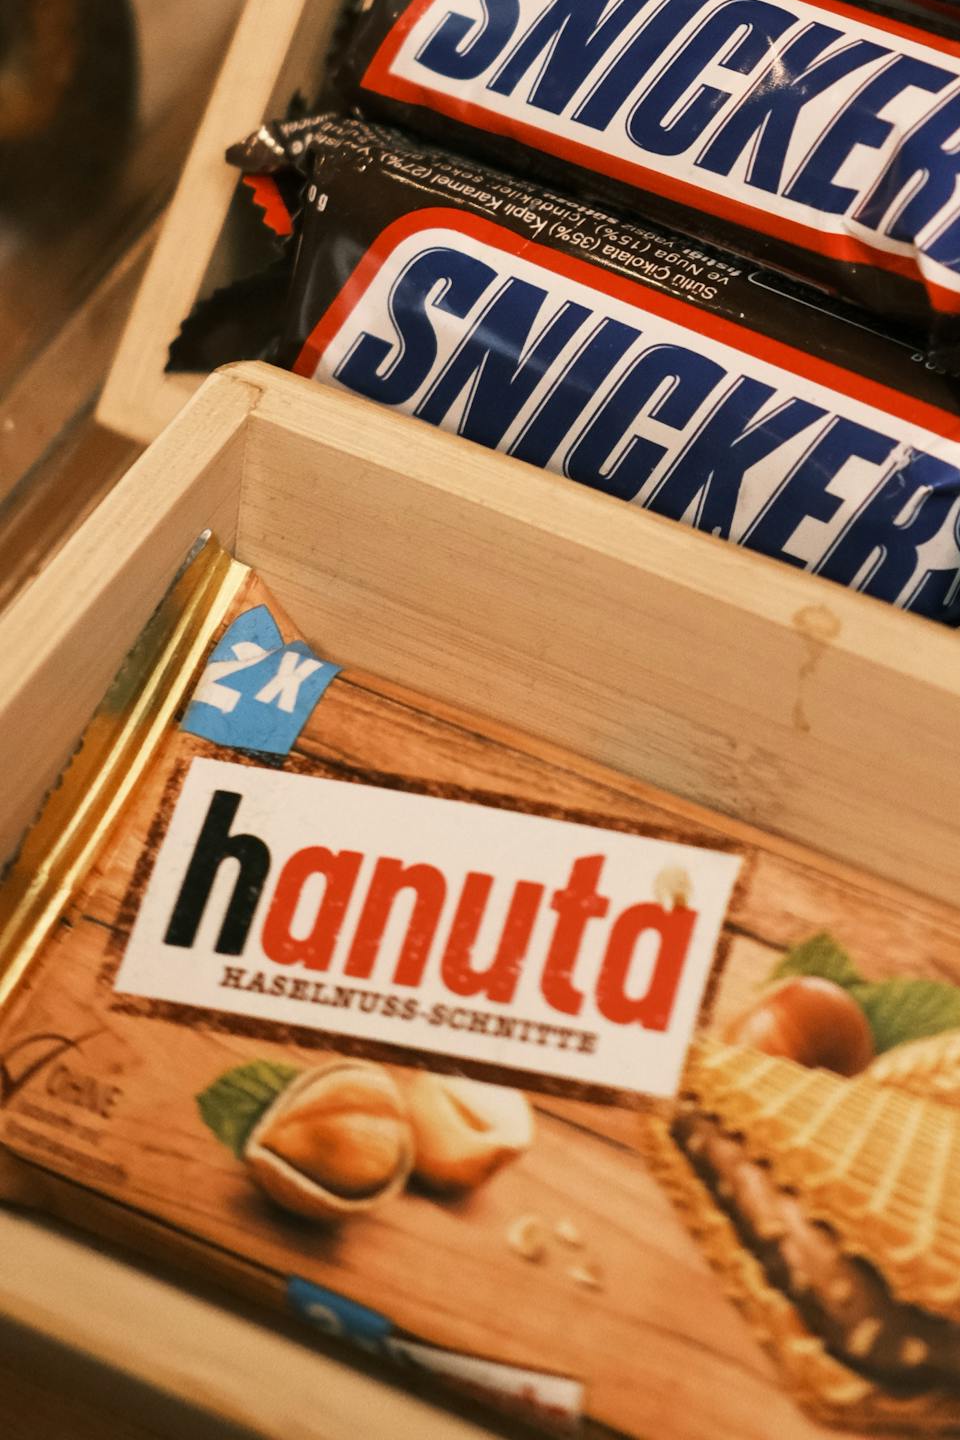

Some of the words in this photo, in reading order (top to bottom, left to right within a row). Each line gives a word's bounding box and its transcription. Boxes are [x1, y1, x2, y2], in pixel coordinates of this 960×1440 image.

[430, 167, 503, 213] Karamel
[500, 198, 549, 237] Kaplı
[547, 217, 601, 254] (35%)
[599, 238, 671, 285] Çikolata
[652, 244, 704, 278] Nuga
[705, 268, 730, 287] ve
[668, 269, 718, 304] Sütlü
[163, 790, 697, 1034] hanuta
[219, 965, 599, 1054] HASELNUSS-SCHNITTE
